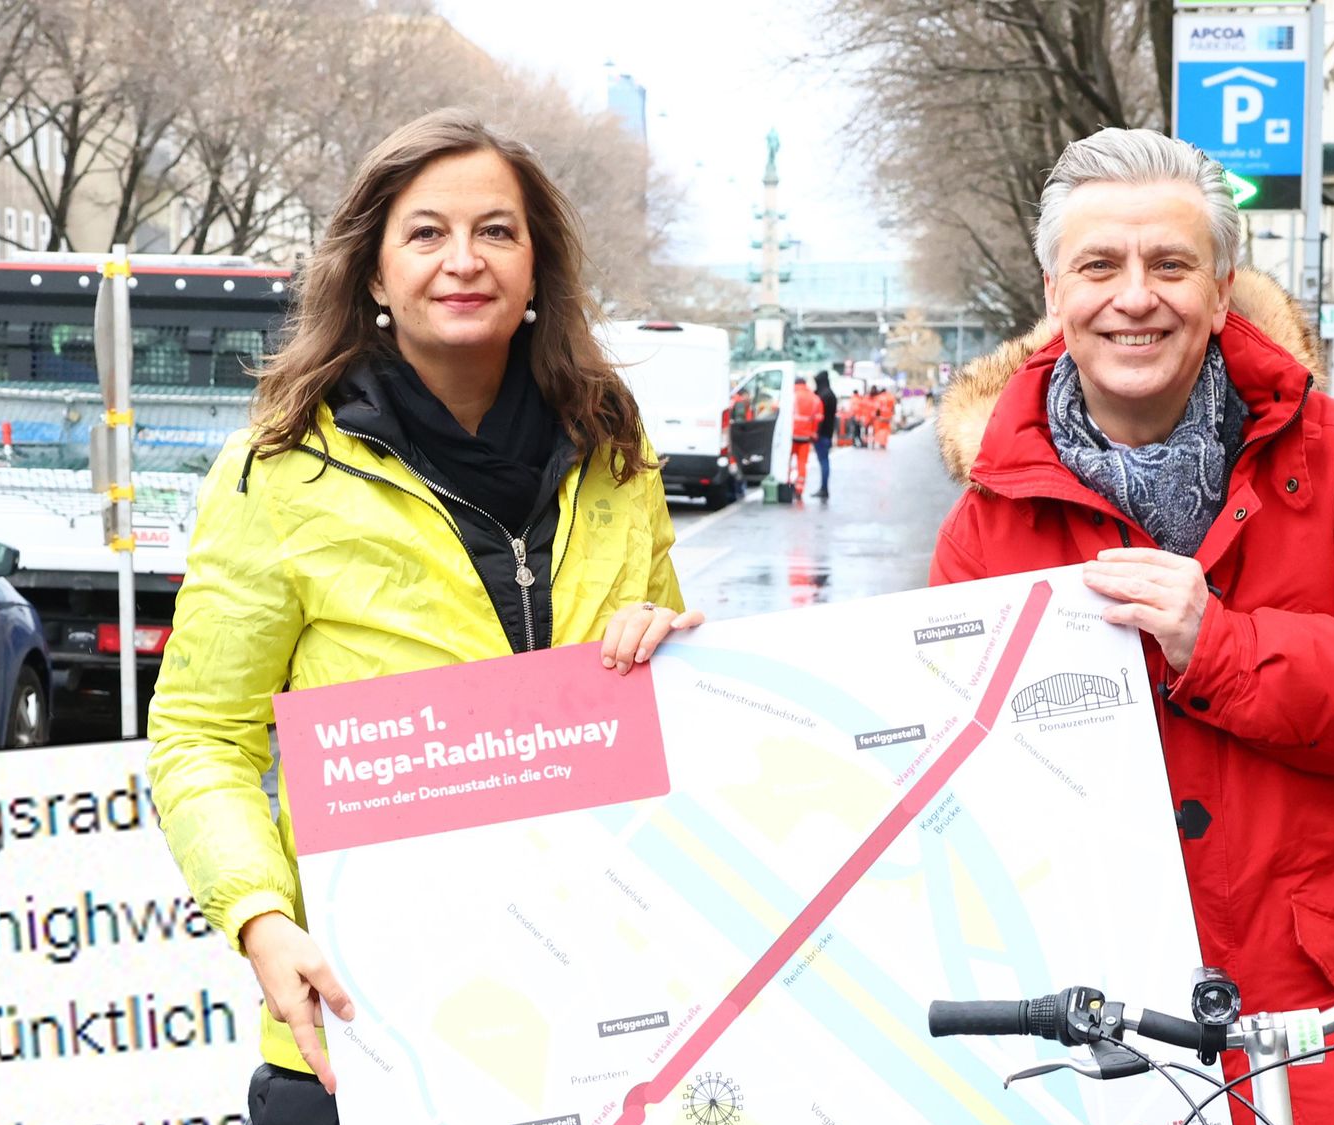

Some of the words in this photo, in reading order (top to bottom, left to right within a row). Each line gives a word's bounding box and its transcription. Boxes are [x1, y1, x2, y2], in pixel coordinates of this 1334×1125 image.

[1190, 27, 1246, 39] APCOA
[1222, 84, 1264, 145] P
[132, 532, 169, 542] ABAG
[917, 626, 956, 642] Frühjahr
[958, 622, 982, 636] 2024
[928, 612, 967, 624] Baustart
[1066, 620, 1091, 632] Platz
[969, 635, 997, 687] Wagramer
[992, 603, 1012, 637] Straße
[915, 650, 972, 701] Siebeckstraße
[695, 680, 817, 729] Arbeiterstrandbadstraße
[1039, 713, 1115, 732] Donauzentrum
[314, 715, 414, 749] Wiens
[420, 706, 446, 732] 1.
[859, 727, 922, 747] fertiggestellt
[323, 719, 618, 785] Mega-Radhighway
[894, 743, 934, 786] Wagramer
[931, 715, 959, 743] Straße
[1014, 732, 1087, 798] Donaustadtstraße
[327, 801, 337, 815] 7
[339, 799, 361, 814] km
[363, 796, 390, 810] von
[392, 789, 416, 805] der
[419, 775, 501, 801] Donaustadt
[503, 772, 516, 786] in
[519, 767, 542, 783] die
[543, 764, 572, 784] City
[919, 792, 957, 831] Kagraner
[933, 805, 961, 835] Brücke
[604, 868, 651, 912] Handelskai
[506, 903, 543, 942] Dresdner
[543, 936, 571, 967] Straße
[783, 932, 834, 987] Reichsbrücke
[602, 1013, 665, 1035] fertiggestellt
[647, 1003, 703, 1064] Lassallestraße
[343, 1026, 394, 1073] Donaukanal
[571, 1068, 629, 1086] Praterstern
